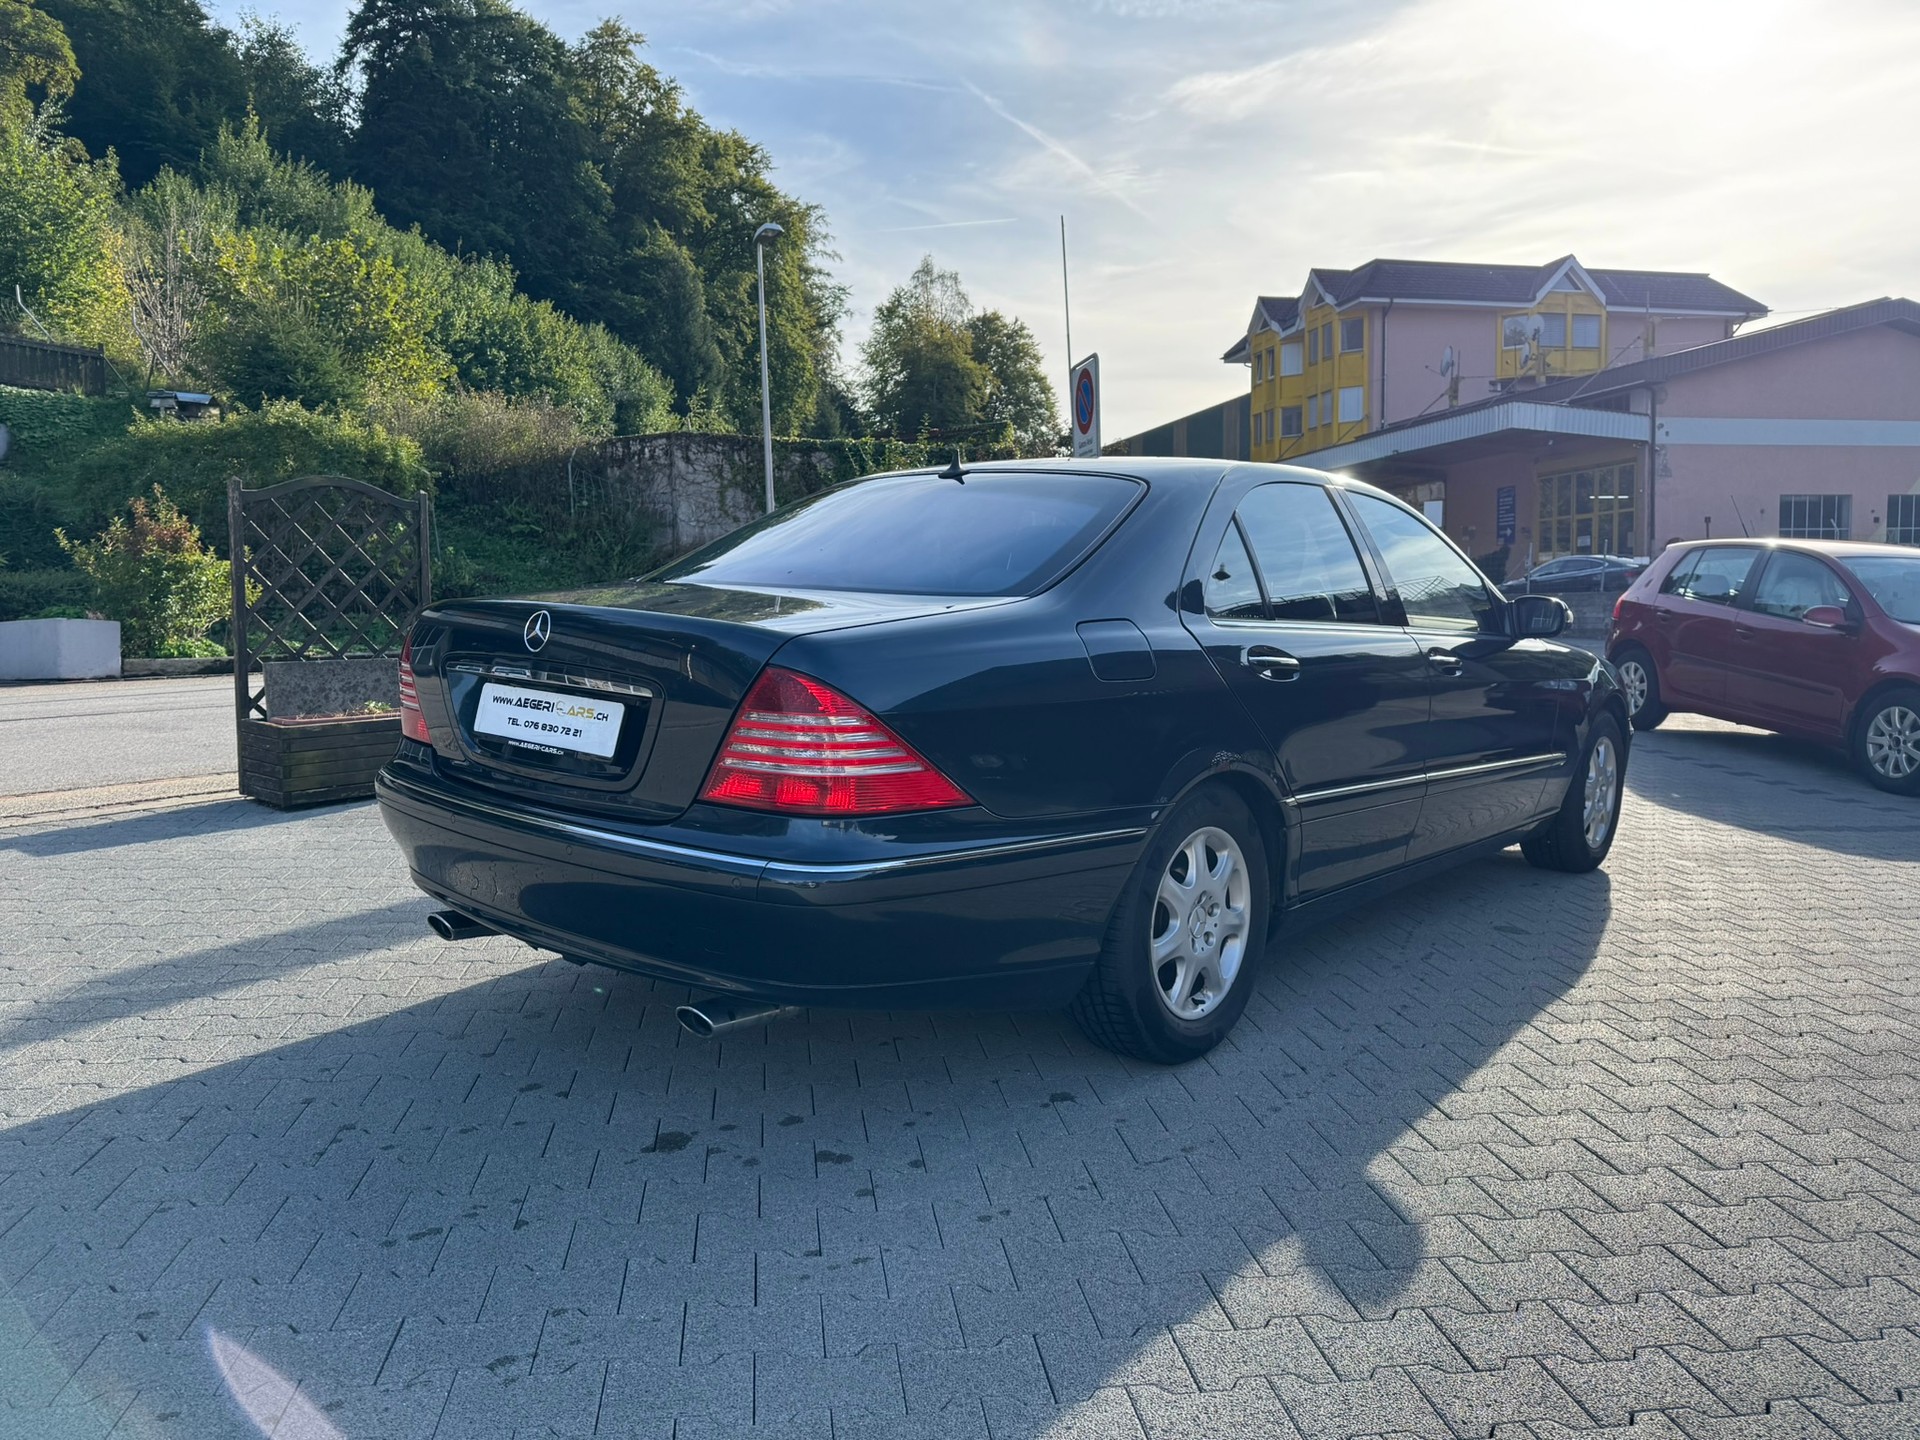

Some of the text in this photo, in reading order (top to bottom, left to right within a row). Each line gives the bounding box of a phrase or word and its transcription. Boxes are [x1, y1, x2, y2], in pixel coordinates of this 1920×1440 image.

[507, 717, 583, 738] TEL. 076 830 72 21
